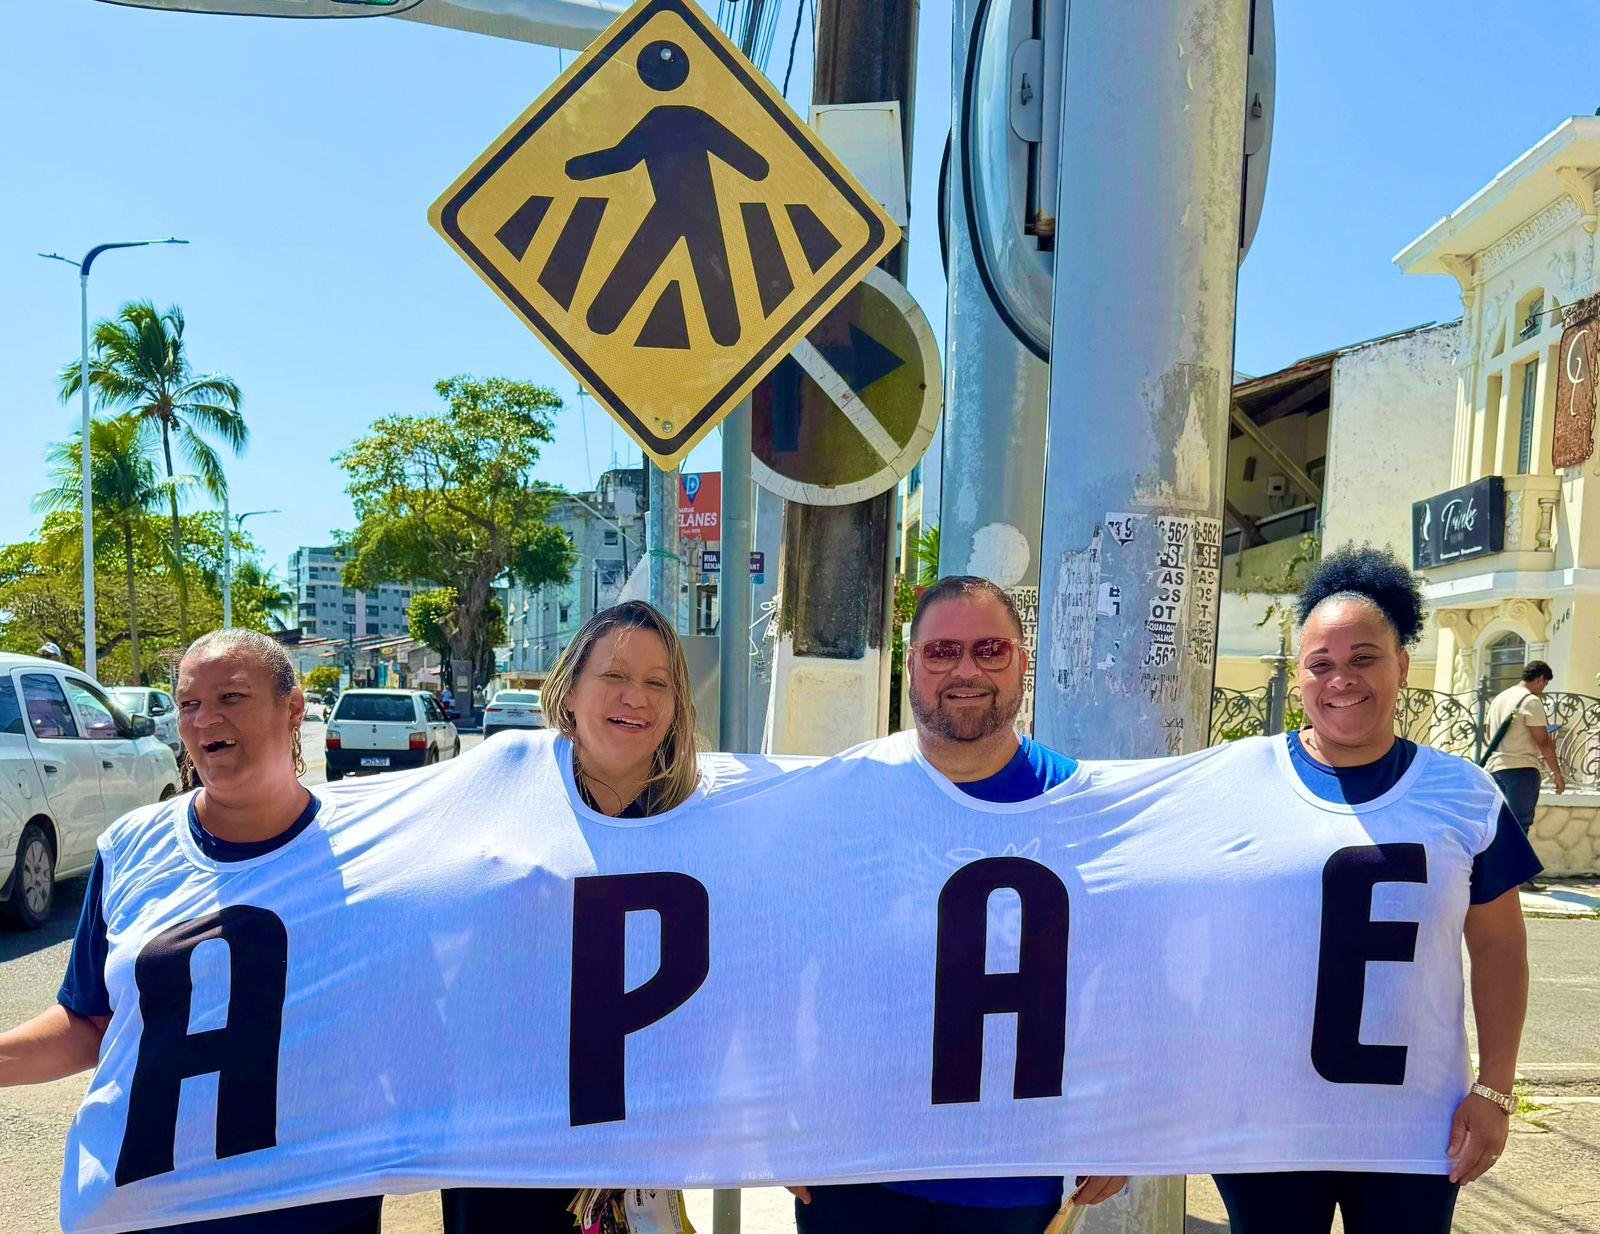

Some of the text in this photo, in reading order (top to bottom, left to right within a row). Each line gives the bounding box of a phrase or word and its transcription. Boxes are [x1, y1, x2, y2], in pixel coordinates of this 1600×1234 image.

[704, 554, 717, 562] RUA
[1161, 570, 1184, 586] AS
[1152, 604, 1176, 619] OT
